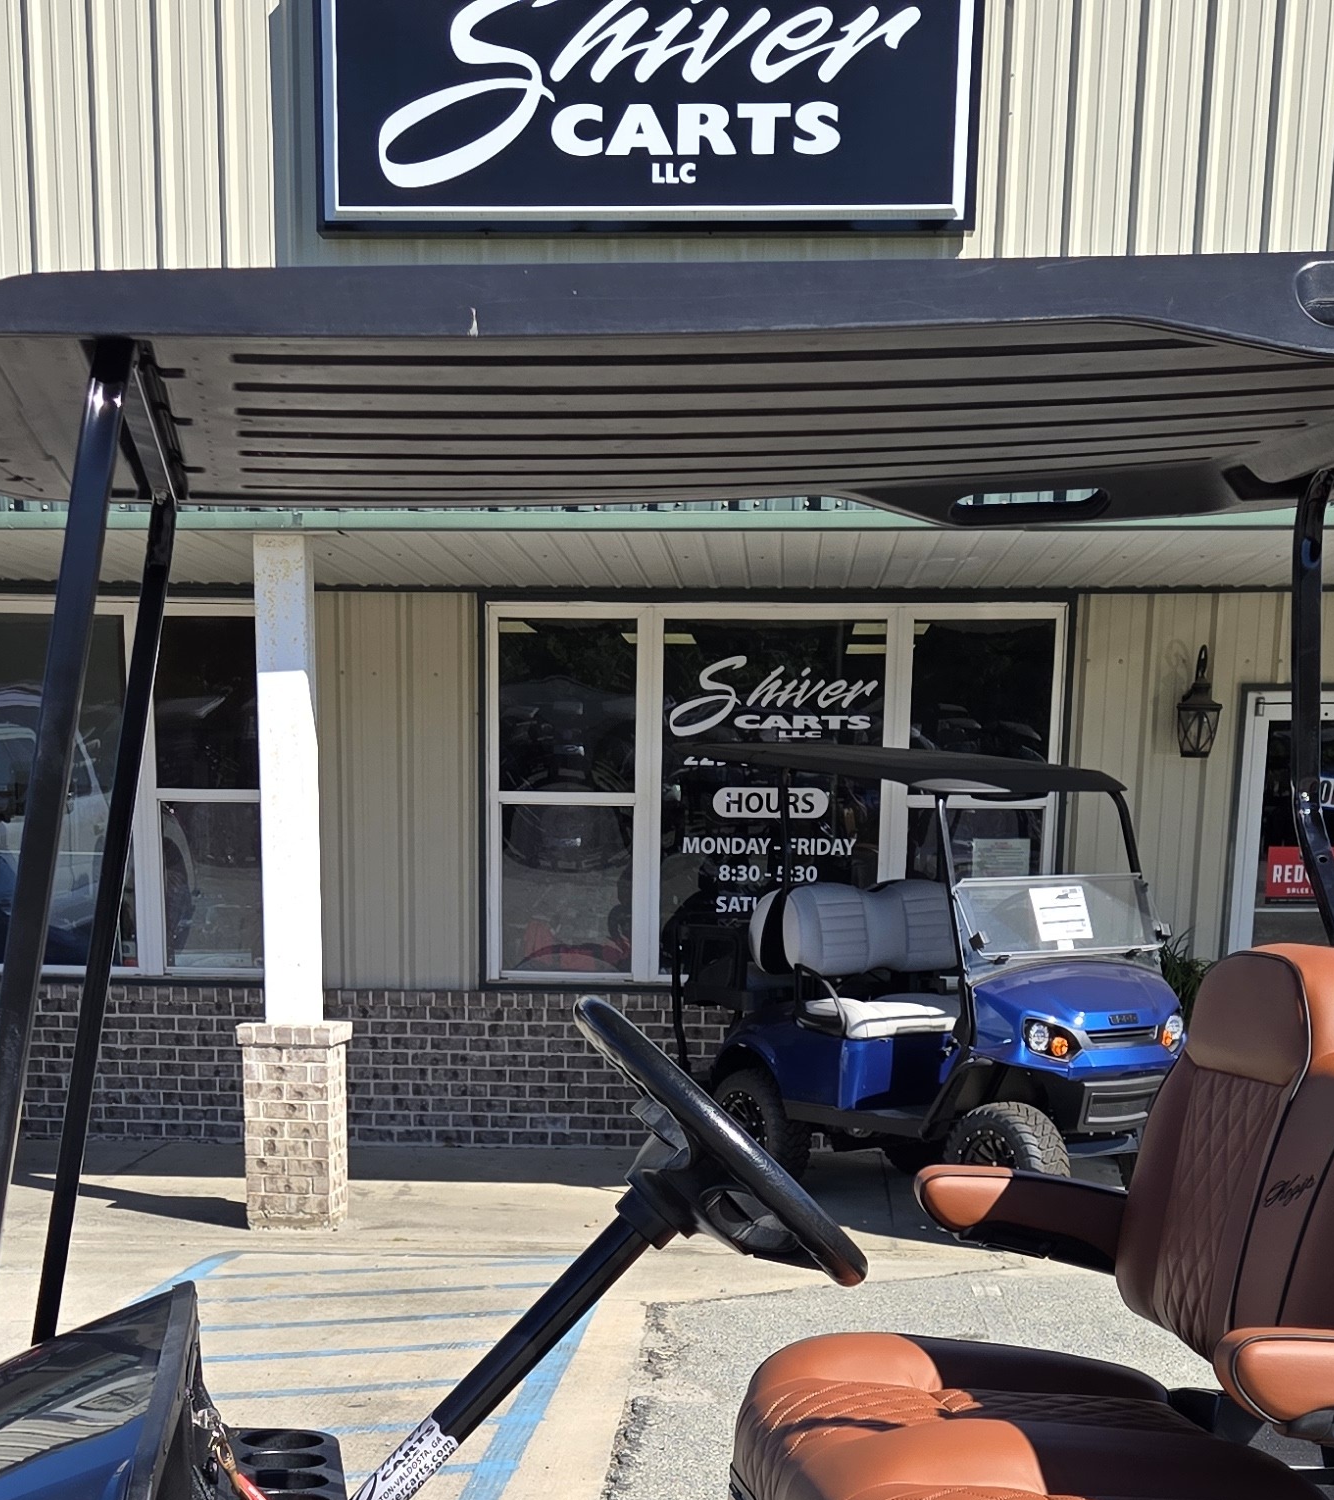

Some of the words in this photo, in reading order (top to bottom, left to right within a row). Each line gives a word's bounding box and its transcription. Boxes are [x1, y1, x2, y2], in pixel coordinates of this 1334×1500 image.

[378, 0, 921, 188] Shiver
[550, 101, 841, 156] CARTS
[651, 162, 697, 185] LLC
[669, 655, 878, 737] Shiver
[733, 715, 871, 730] CARTS
[779, 730, 821, 738] LLC
[725, 792, 815, 814] HOURS
[682, 836, 771, 855] MONDAY
[718, 864, 761, 882] 8:30
[1272, 864, 1305, 884] RED
[381, 1424, 435, 1482] CARTS
[431, 1436, 443, 1449] GA
